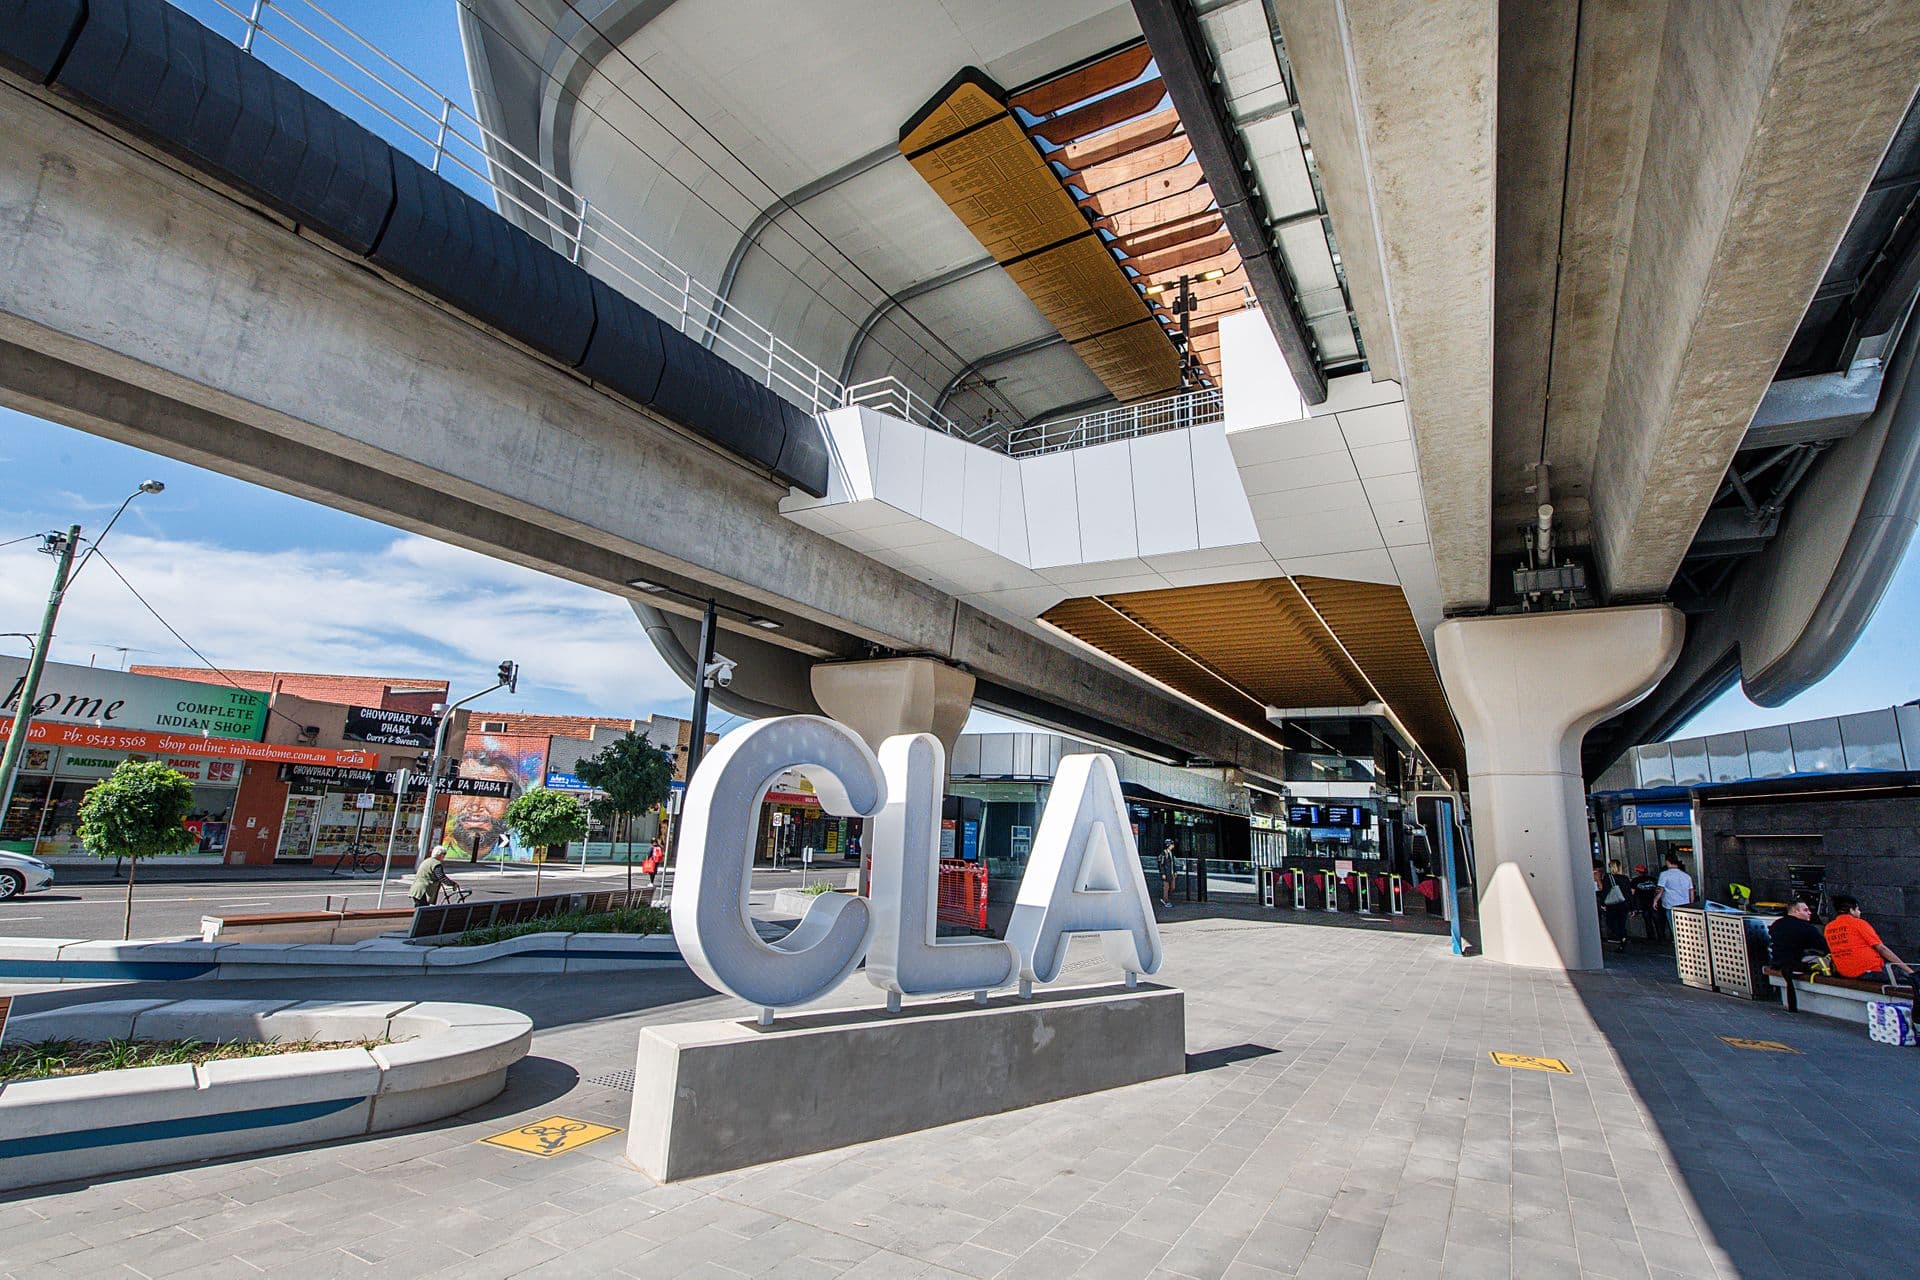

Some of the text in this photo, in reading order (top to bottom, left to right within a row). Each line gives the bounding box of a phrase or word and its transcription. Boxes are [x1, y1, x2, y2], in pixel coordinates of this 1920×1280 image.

[230, 693, 257, 706] THE
[176, 701, 254, 720] COMPLETE
[360, 708, 432, 726] CHOWDHARY DA
[156, 714, 209, 729] INDIAN
[213, 721, 251, 734] SHOP
[381, 723, 411, 735] DHABA
[63, 727, 83, 742] Ph:
[86, 734, 116, 747] 9543
[119, 736, 146, 748] 5568
[159, 735, 186, 753] Shop
[188, 739, 227, 754] online:
[230, 744, 327, 762] indiaathome.com.au
[366, 733, 386, 744] Curry
[395, 735, 419, 746] Sweets
[168, 759, 201, 769] PACIFIC
[336, 752, 364, 764] india
[293, 765, 336, 777] CHOWDHARY
[349, 770, 371, 781] DHABA
[457, 780, 469, 790] DA
[473, 781, 501, 792] DHABA
[1637, 809, 1684, 818] Customer Service
